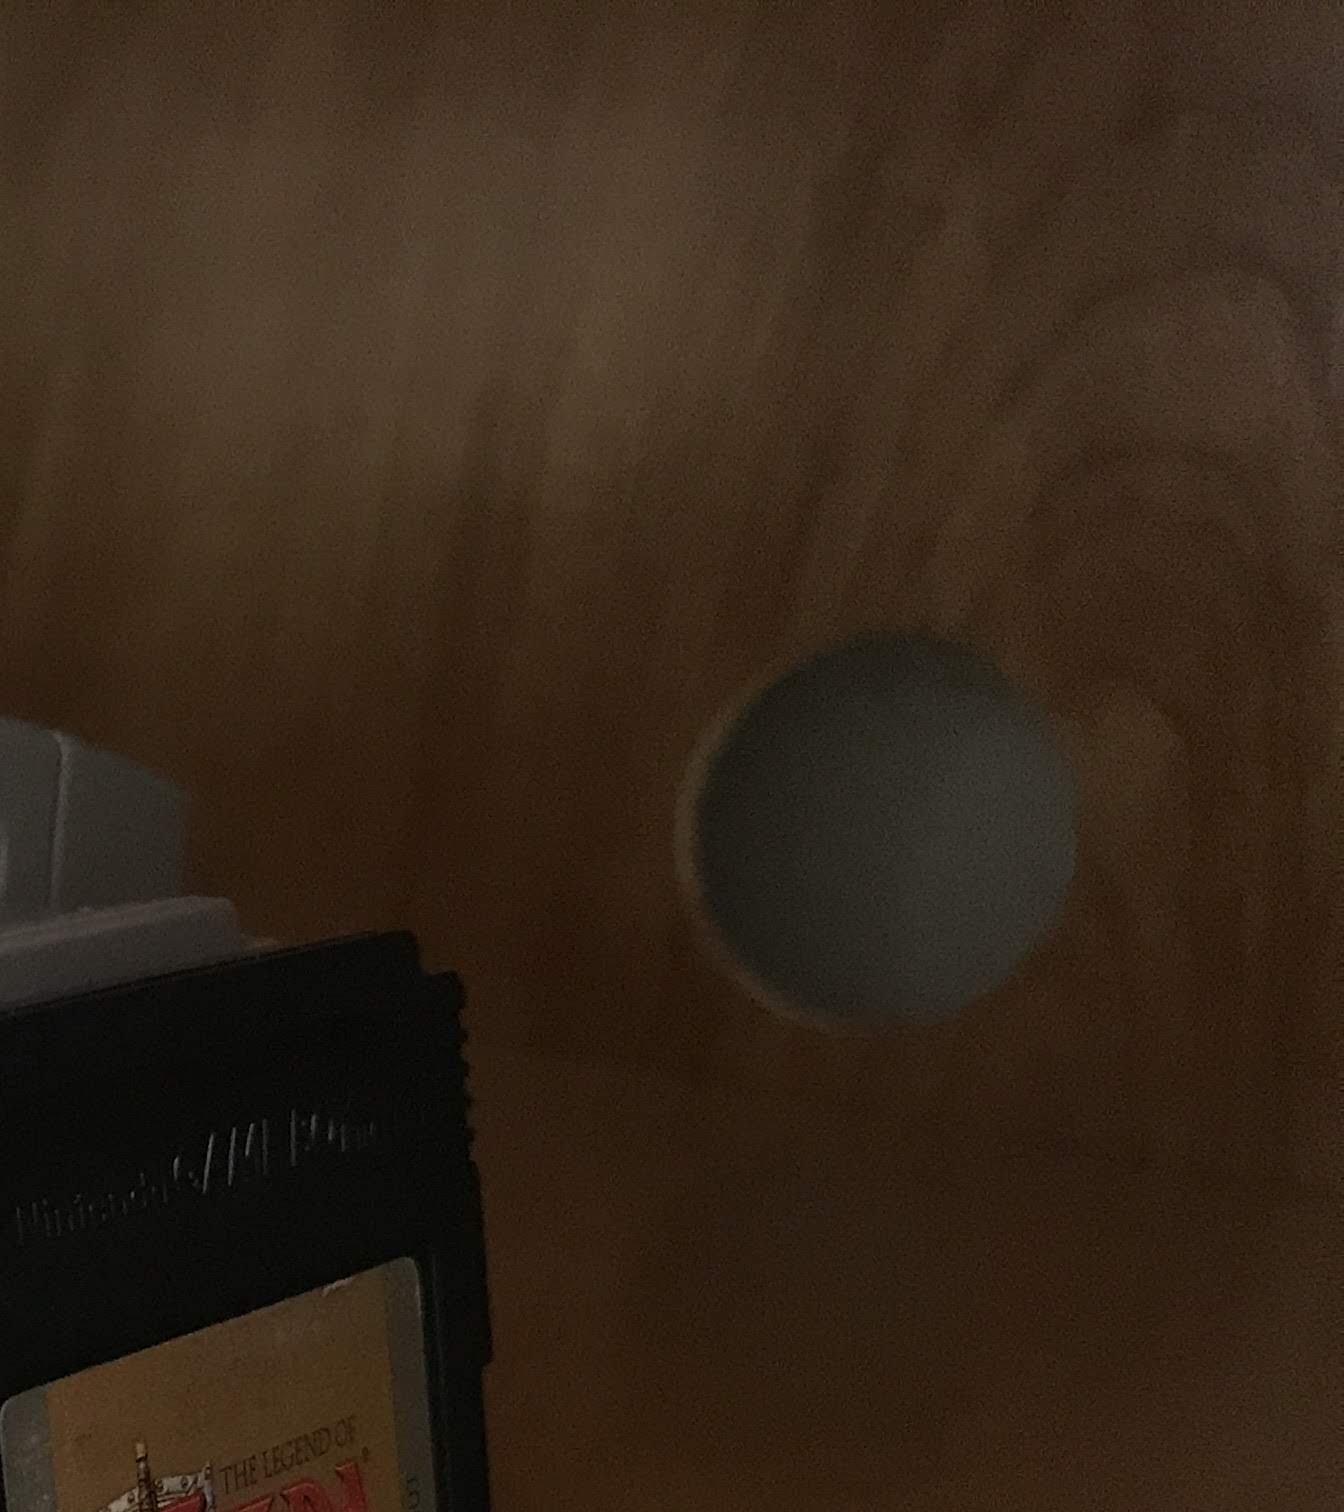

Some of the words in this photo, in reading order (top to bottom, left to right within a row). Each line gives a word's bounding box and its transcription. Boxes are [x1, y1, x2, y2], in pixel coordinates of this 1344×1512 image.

[220, 1456, 257, 1494] THE
[262, 1427, 332, 1478] LEGEND
[334, 1415, 359, 1450] OF
